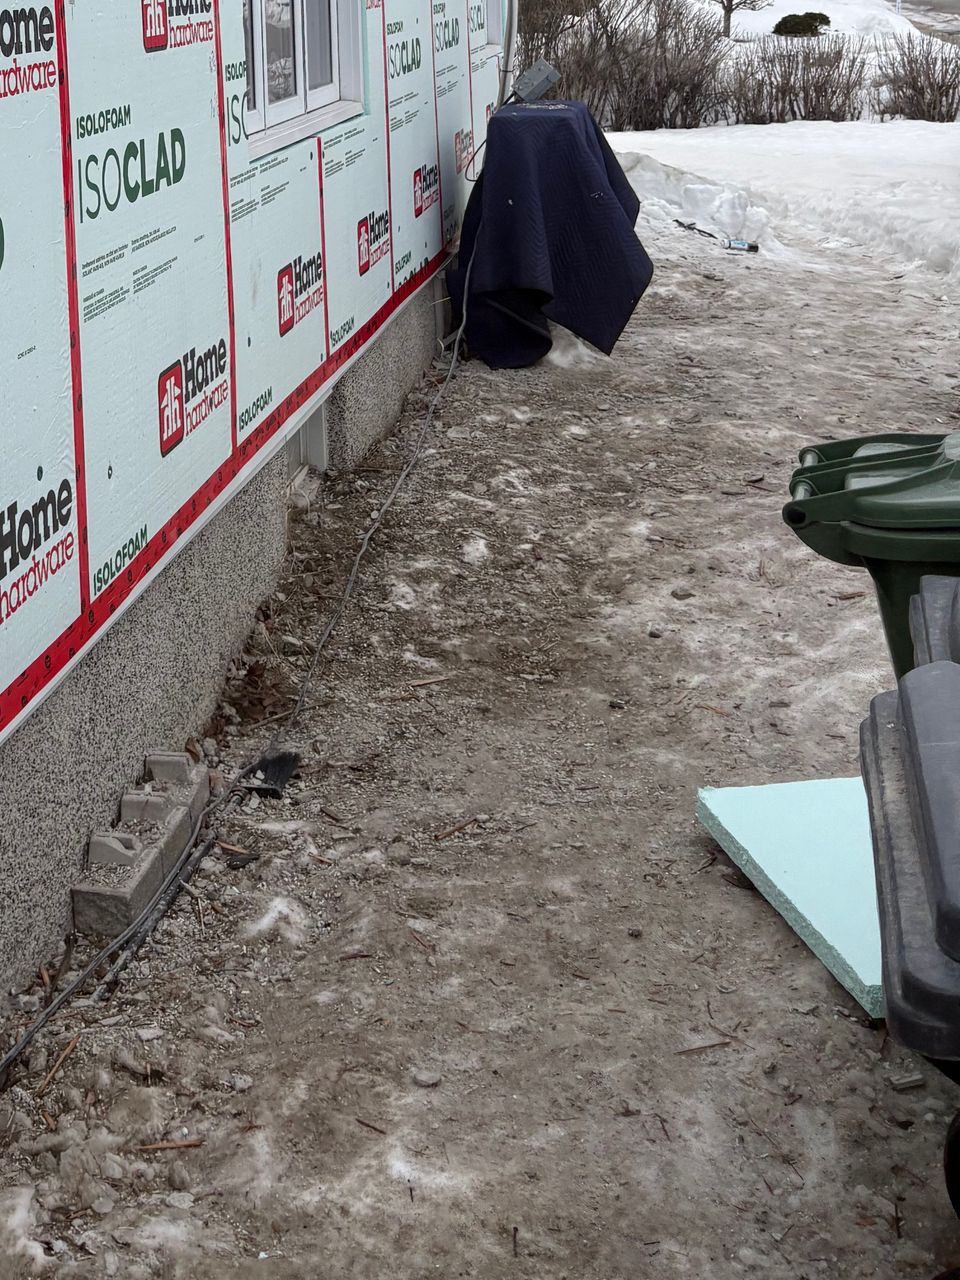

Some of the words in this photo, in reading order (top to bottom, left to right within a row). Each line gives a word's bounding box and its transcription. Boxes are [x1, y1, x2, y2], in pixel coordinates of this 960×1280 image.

[167, 17, 215, 50] hardware
[387, 37, 421, 80] ISOCLAD
[75, 103, 131, 140] ISOLOFOAM
[77, 127, 187, 225] ISOCLAD
[293, 251, 323, 300] Home
[182, 338, 228, 405] Home
[184, 378, 230, 438] hardware
[238, 386, 272, 433] ISOLOFOAM
[93, 522, 147, 596] ISOLOFOAM
